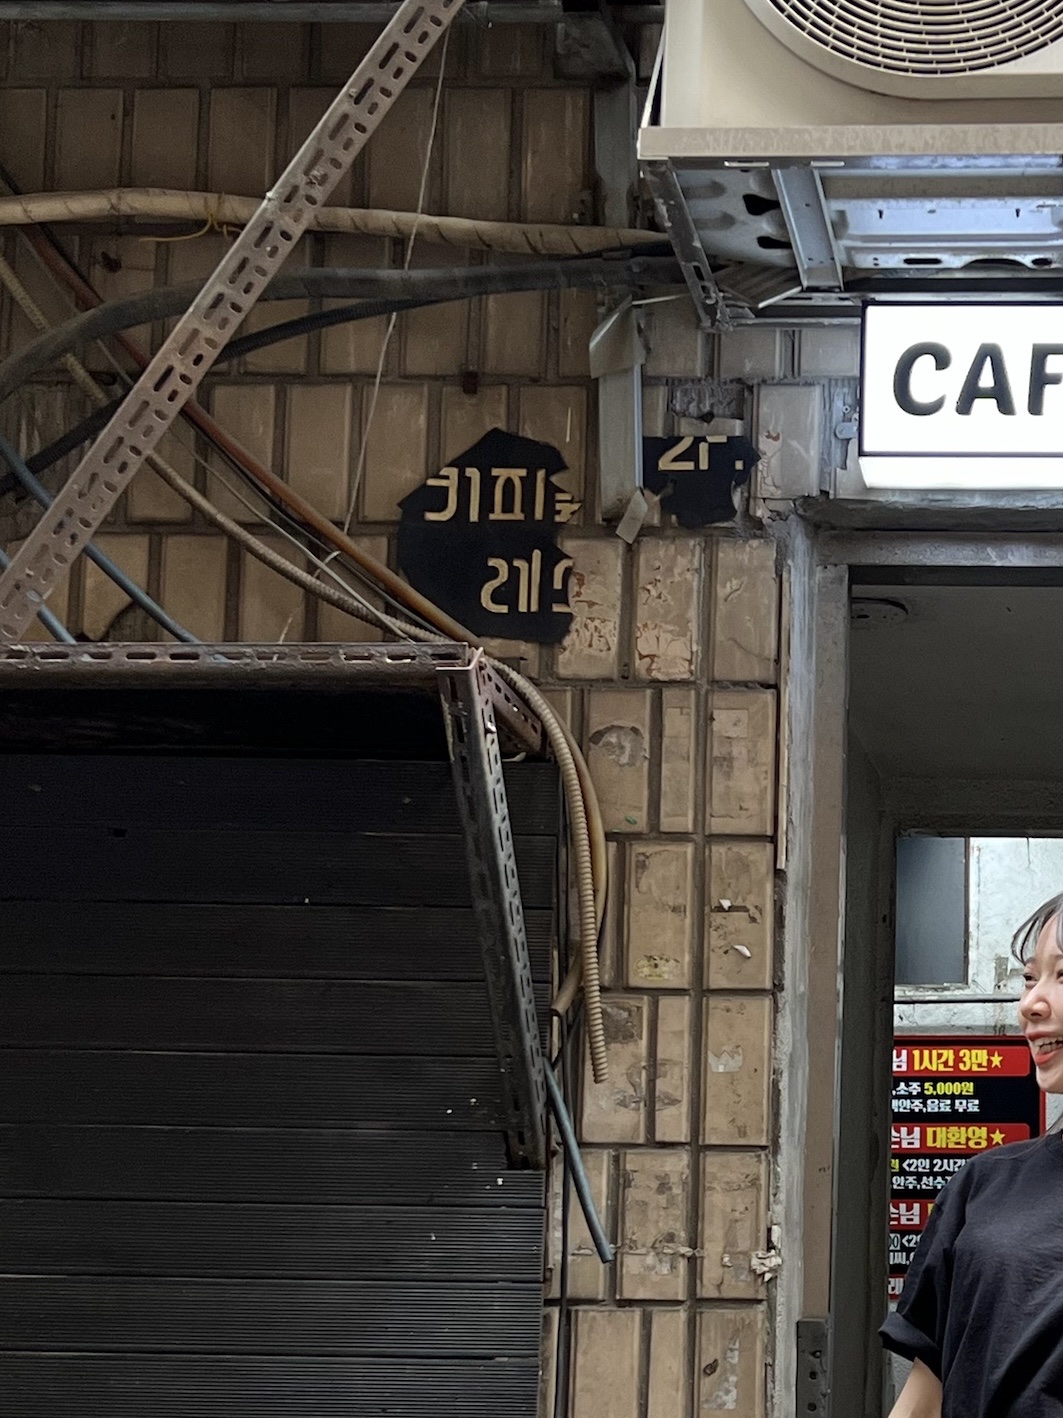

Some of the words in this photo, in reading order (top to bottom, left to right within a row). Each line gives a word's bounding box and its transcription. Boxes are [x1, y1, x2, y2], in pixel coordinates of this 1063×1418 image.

[912, 1049, 955, 1071] 1시간
[959, 1049, 988, 1071] 3만
[924, 1082, 975, 1095] 5,000원
[955, 1099, 980, 1112] 무료
[927, 1126, 987, 1149] 대환영
